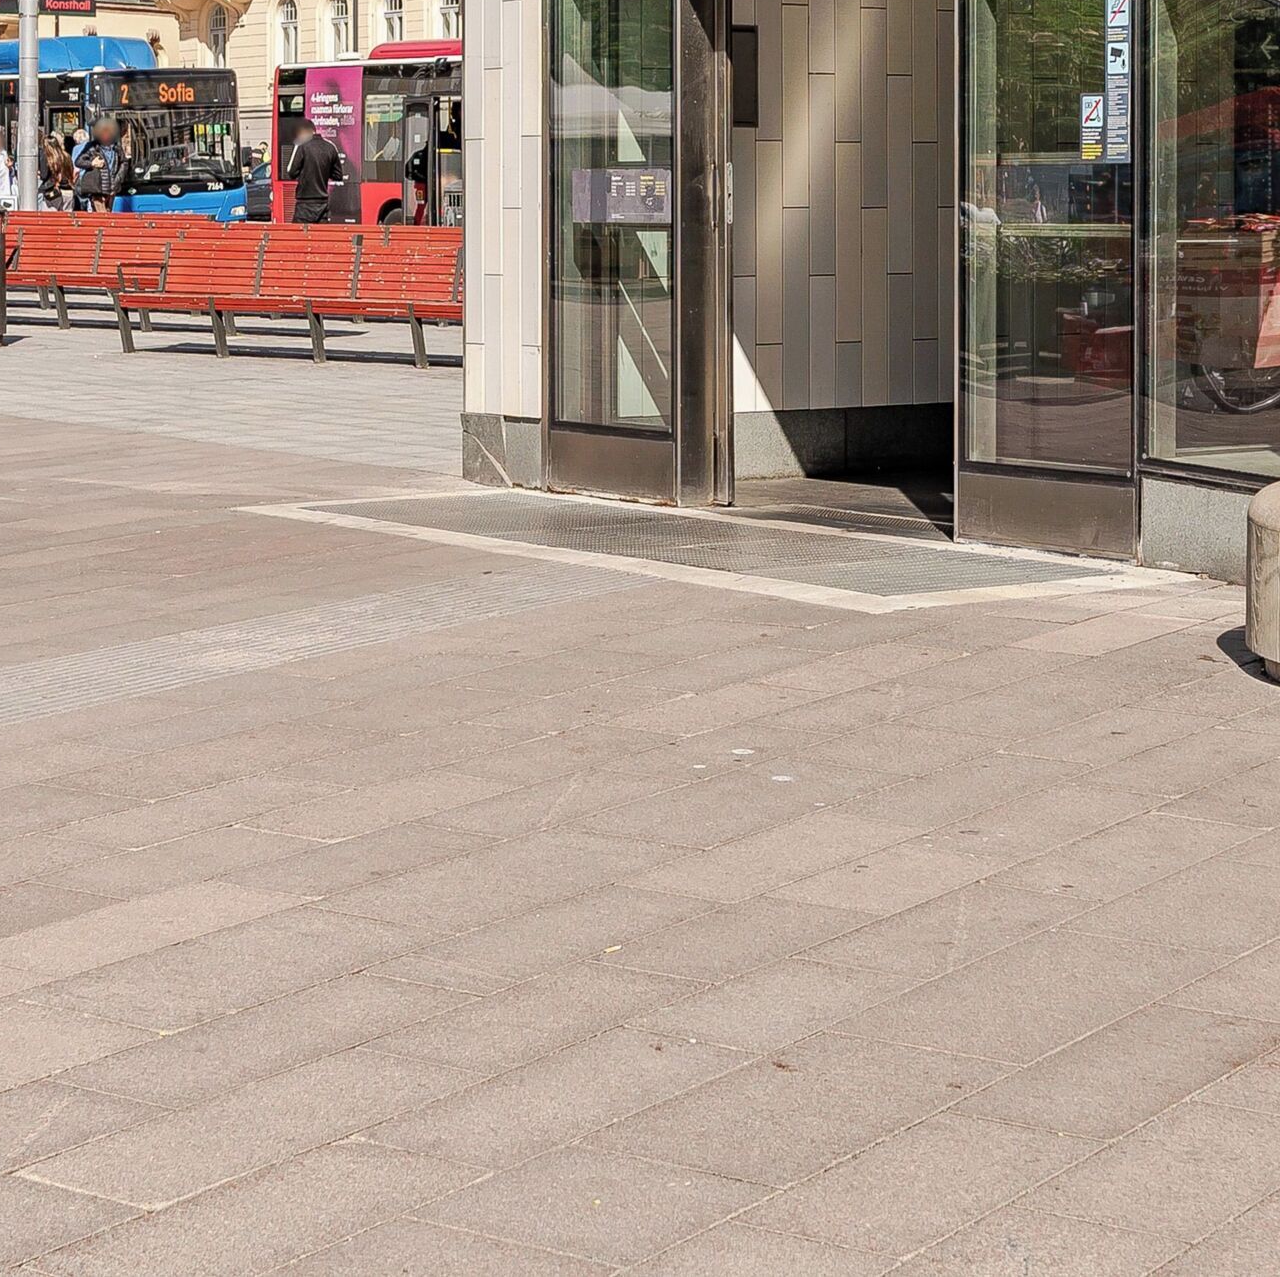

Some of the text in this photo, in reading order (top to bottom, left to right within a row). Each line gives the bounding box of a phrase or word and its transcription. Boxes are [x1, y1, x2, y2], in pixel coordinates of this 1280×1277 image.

[120, 82, 195, 104] 2 Sofia
[207, 182, 224, 191] 7164
